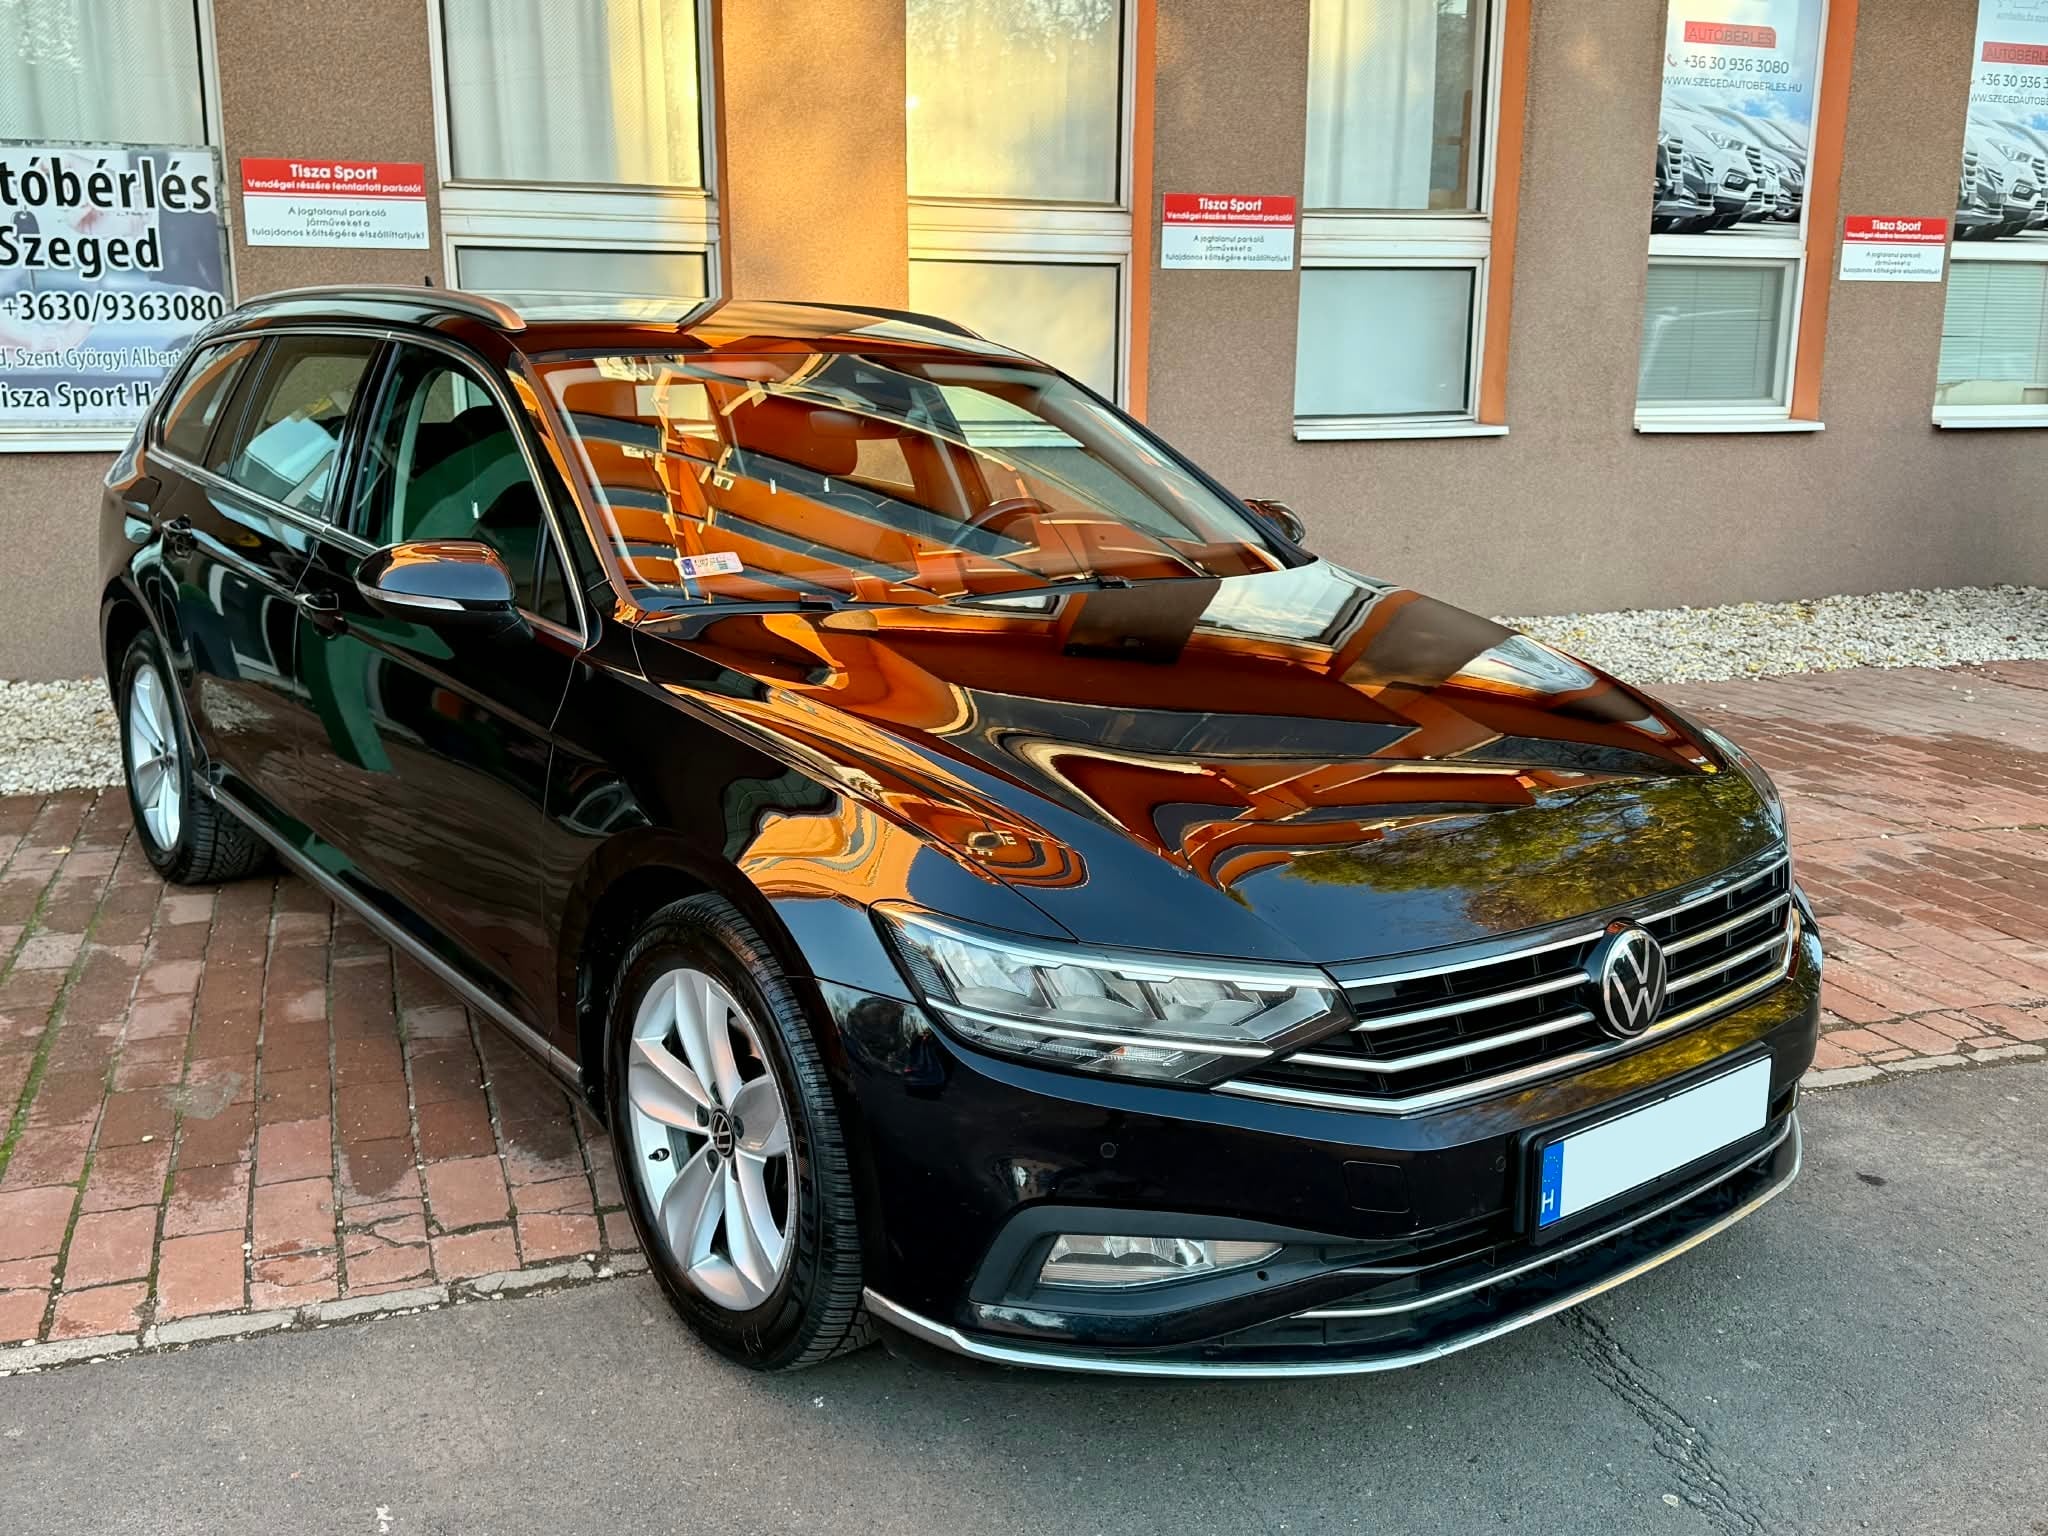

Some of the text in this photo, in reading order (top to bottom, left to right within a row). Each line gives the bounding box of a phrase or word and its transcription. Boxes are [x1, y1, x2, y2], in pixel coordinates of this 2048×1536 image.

[1684, 54, 1790, 74] +36 30 936 3080
[1981, 72, 2001, 87] +36
[2002, 74, 2018, 88] 30
[2020, 75, 2041, 89] 936
[0, 156, 212, 210] tóbérlés
[289, 163, 378, 181] Tisza Sport
[288, 206, 296, 215] A
[1198, 197, 1262, 213] Tisza Sport
[1871, 219, 1922, 232] Tisza Sport
[0, 225, 161, 279] Szeged
[2, 292, 224, 322] +3630/9363080
[16, 347, 62, 367] Szent
[65, 348, 127, 371] Györgyi
[57, 383, 128, 412] Sport
[1541, 1188, 1555, 1215] H
